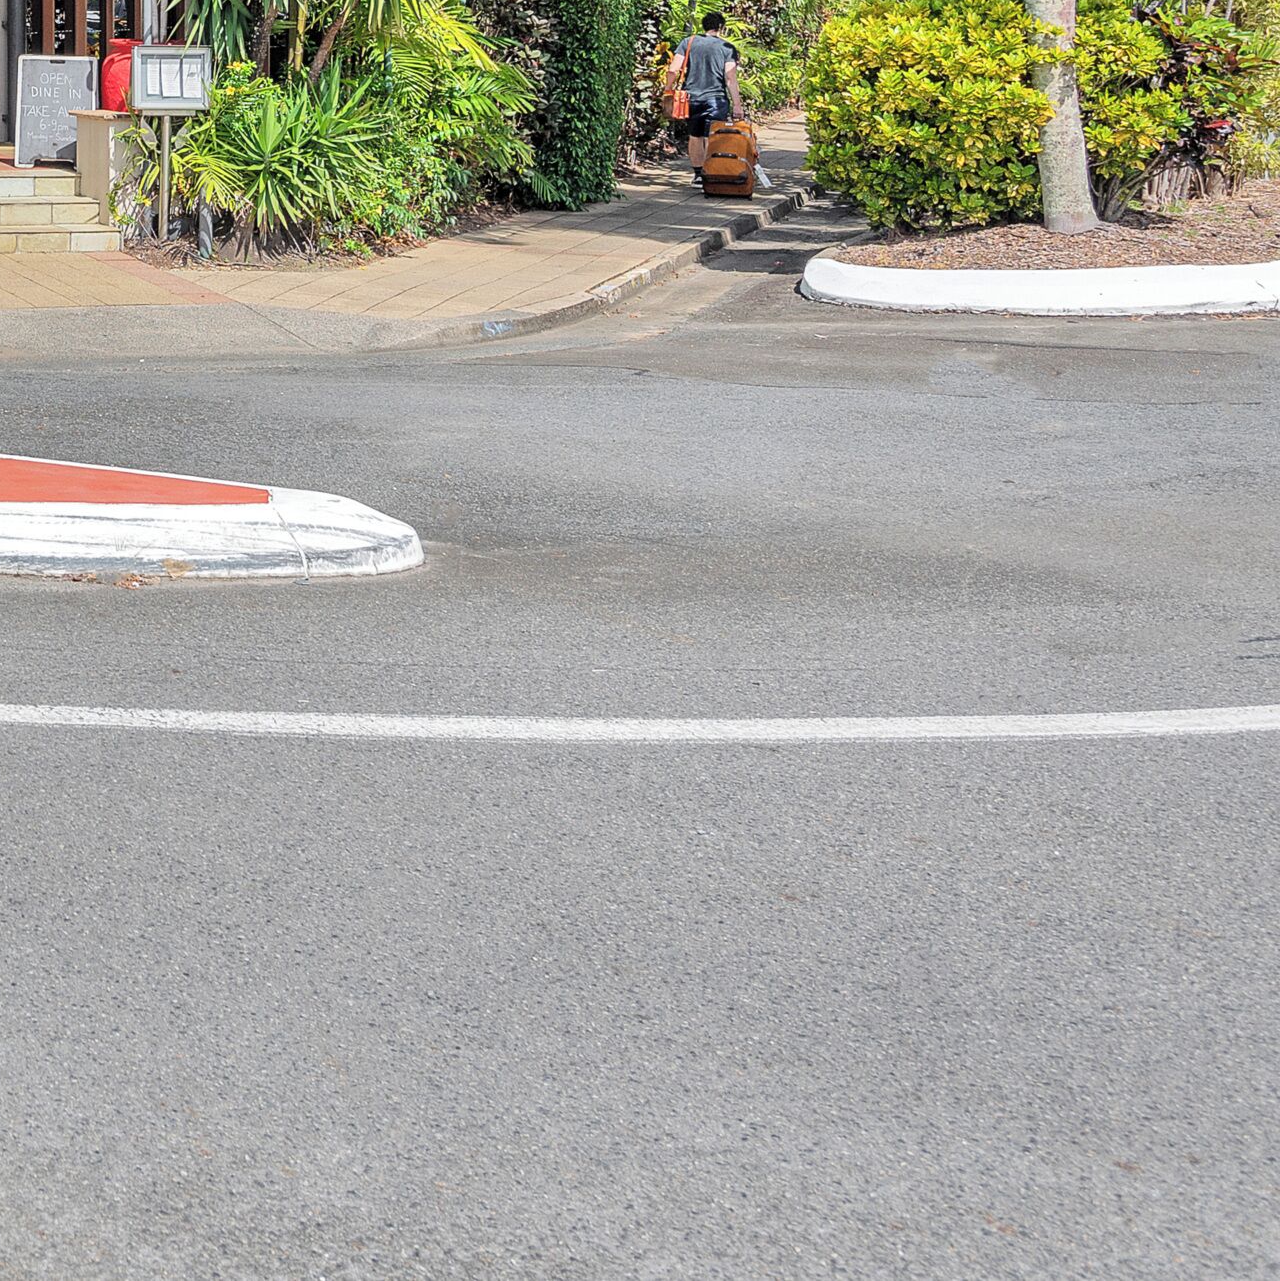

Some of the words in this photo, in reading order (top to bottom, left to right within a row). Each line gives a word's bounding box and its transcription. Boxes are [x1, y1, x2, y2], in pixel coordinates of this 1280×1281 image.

[40, 72, 73, 88] OPEN
[31, 86, 60, 98] DINE
[69, 88, 82, 99] IN
